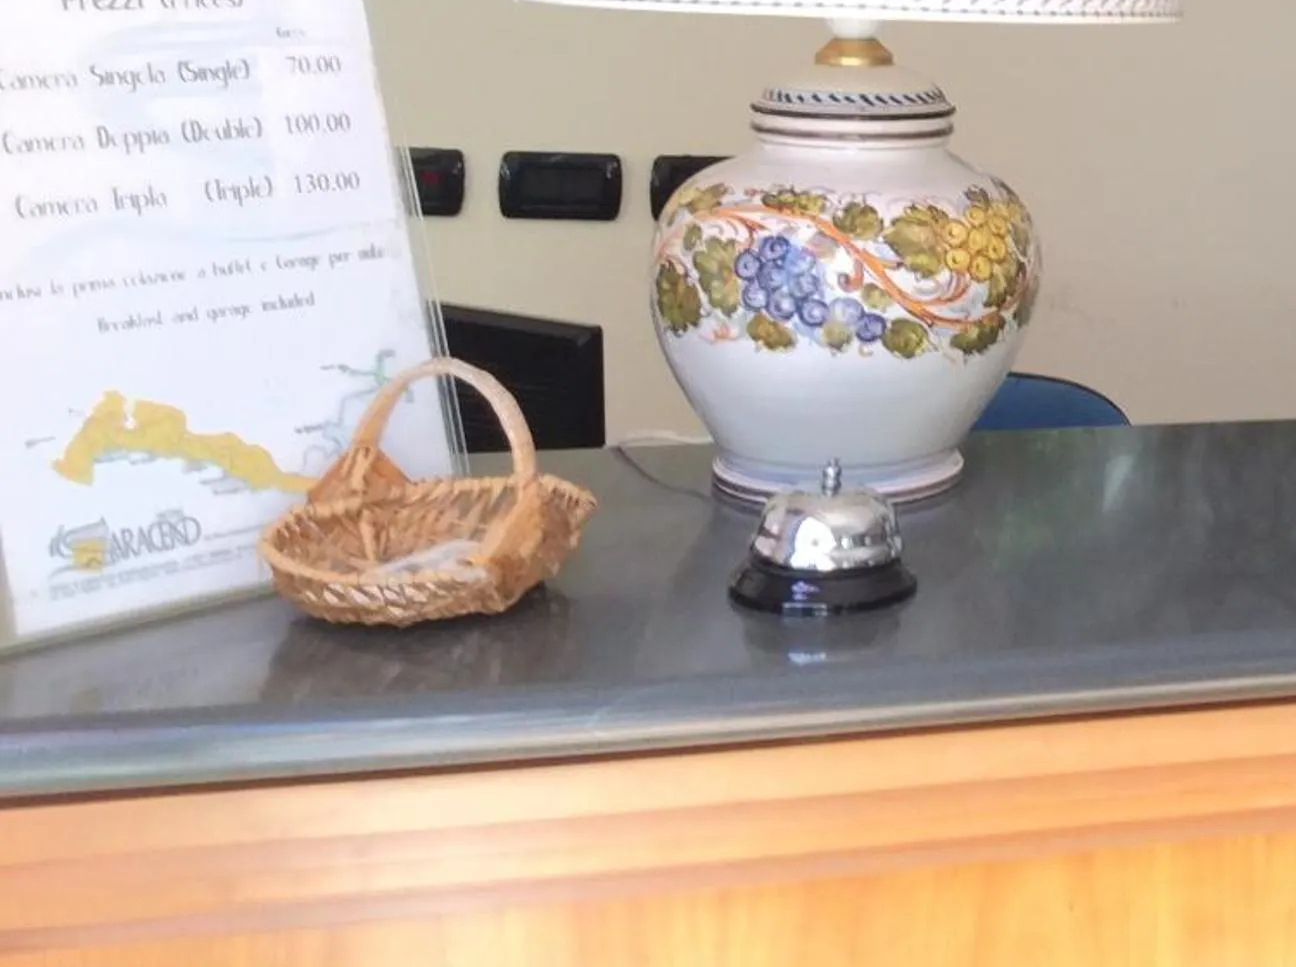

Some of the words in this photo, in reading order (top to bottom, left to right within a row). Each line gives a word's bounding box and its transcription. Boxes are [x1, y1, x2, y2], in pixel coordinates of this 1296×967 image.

[177, 58, 251, 90] (Single)
[285, 55, 343, 75] 70.00
[2, 130, 85, 155] Camera
[284, 112, 352, 135] 100.00
[14, 194, 98, 220] Camera
[293, 171, 361, 194] 130.00
